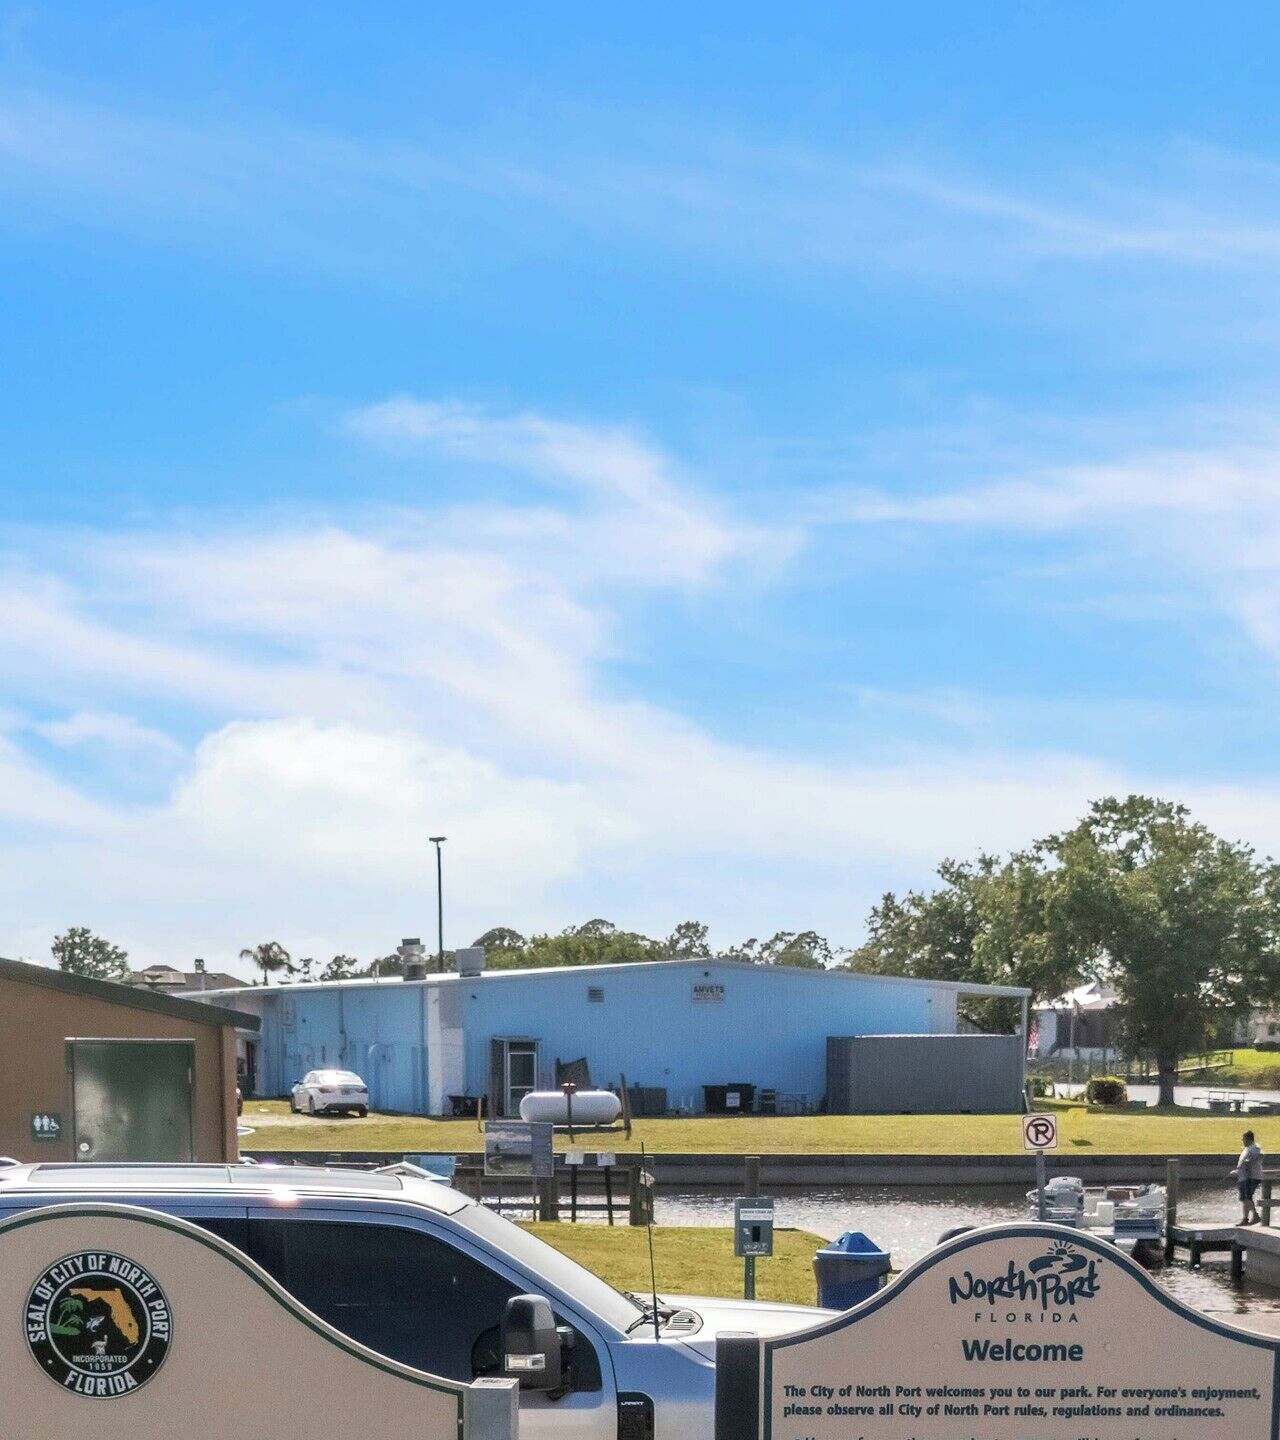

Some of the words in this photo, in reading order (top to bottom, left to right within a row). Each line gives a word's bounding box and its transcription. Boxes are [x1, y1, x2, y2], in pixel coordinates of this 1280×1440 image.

[693, 985, 725, 993] AMVETS
[50, 1254, 85, 1284] CITY
[87, 1254, 107, 1271] OF
[108, 1256, 158, 1298] NORTH
[35, 1278, 55, 1300] OF
[27, 1303, 47, 1343] SEAL
[148, 1299, 170, 1342] PORT
[973, 1311, 1078, 1323] FLORIDA
[72, 1355, 128, 1363] INCORPORATED
[960, 1337, 1084, 1362] Welcome
[64, 1370, 139, 1396] FLORIDA
[782, 1383, 807, 1397] The
[809, 1384, 835, 1400] City
[837, 1383, 852, 1397] of
[855, 1384, 891, 1398] North
[894, 1384, 922, 1397] Port
[924, 1384, 985, 1398] welcomes
[988, 1387, 1013, 1400] you
[1015, 1385, 1031, 1398] to
[1033, 1387, 1056, 1398] our
[1059, 1384, 1093, 1401] park.
[1095, 1385, 1118, 1398] For
[1120, 1385, 1187, 1402] everyone's
[1190, 1384, 1261, 1402] enjoyment,
[782, 1402, 823, 1418] please
[825, 1402, 875, 1416] observe
[877, 1402, 894, 1416] all
[897, 1402, 923, 1418] City
[925, 1402, 941, 1416] of
[943, 1402, 979, 1416] North
[982, 1403, 1010, 1416] Port
[1013, 1402, 1048, 1418] rules,
[1051, 1403, 1122, 1419] regulations
[1125, 1403, 1150, 1417] and
[1153, 1403, 1225, 1417] ordinances.
